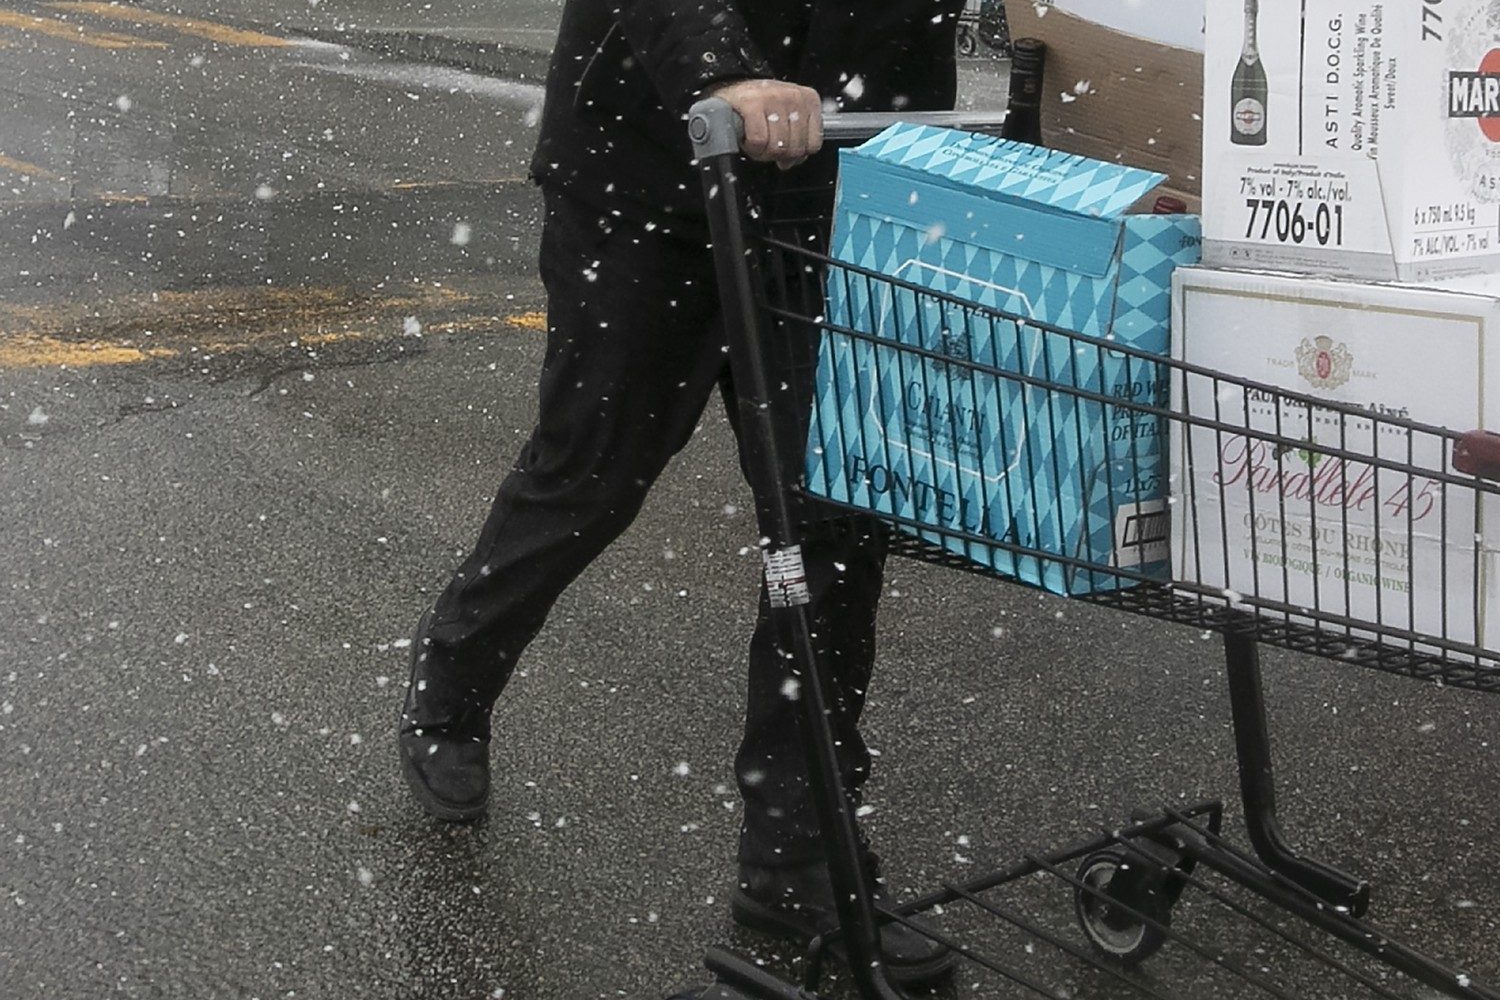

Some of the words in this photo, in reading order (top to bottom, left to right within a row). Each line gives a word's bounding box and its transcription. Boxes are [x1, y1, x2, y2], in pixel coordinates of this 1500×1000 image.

[1327, 13, 1343, 84] D.O.C.G.
[1326, 95, 1338, 148] ASTI
[1240, 177, 1255, 195] 7%
[1260, 178, 1275, 197] vol
[1287, 180, 1303, 198] 7%
[1246, 199, 1342, 246] 7706-01
[1384, 476, 1441, 521] 45
